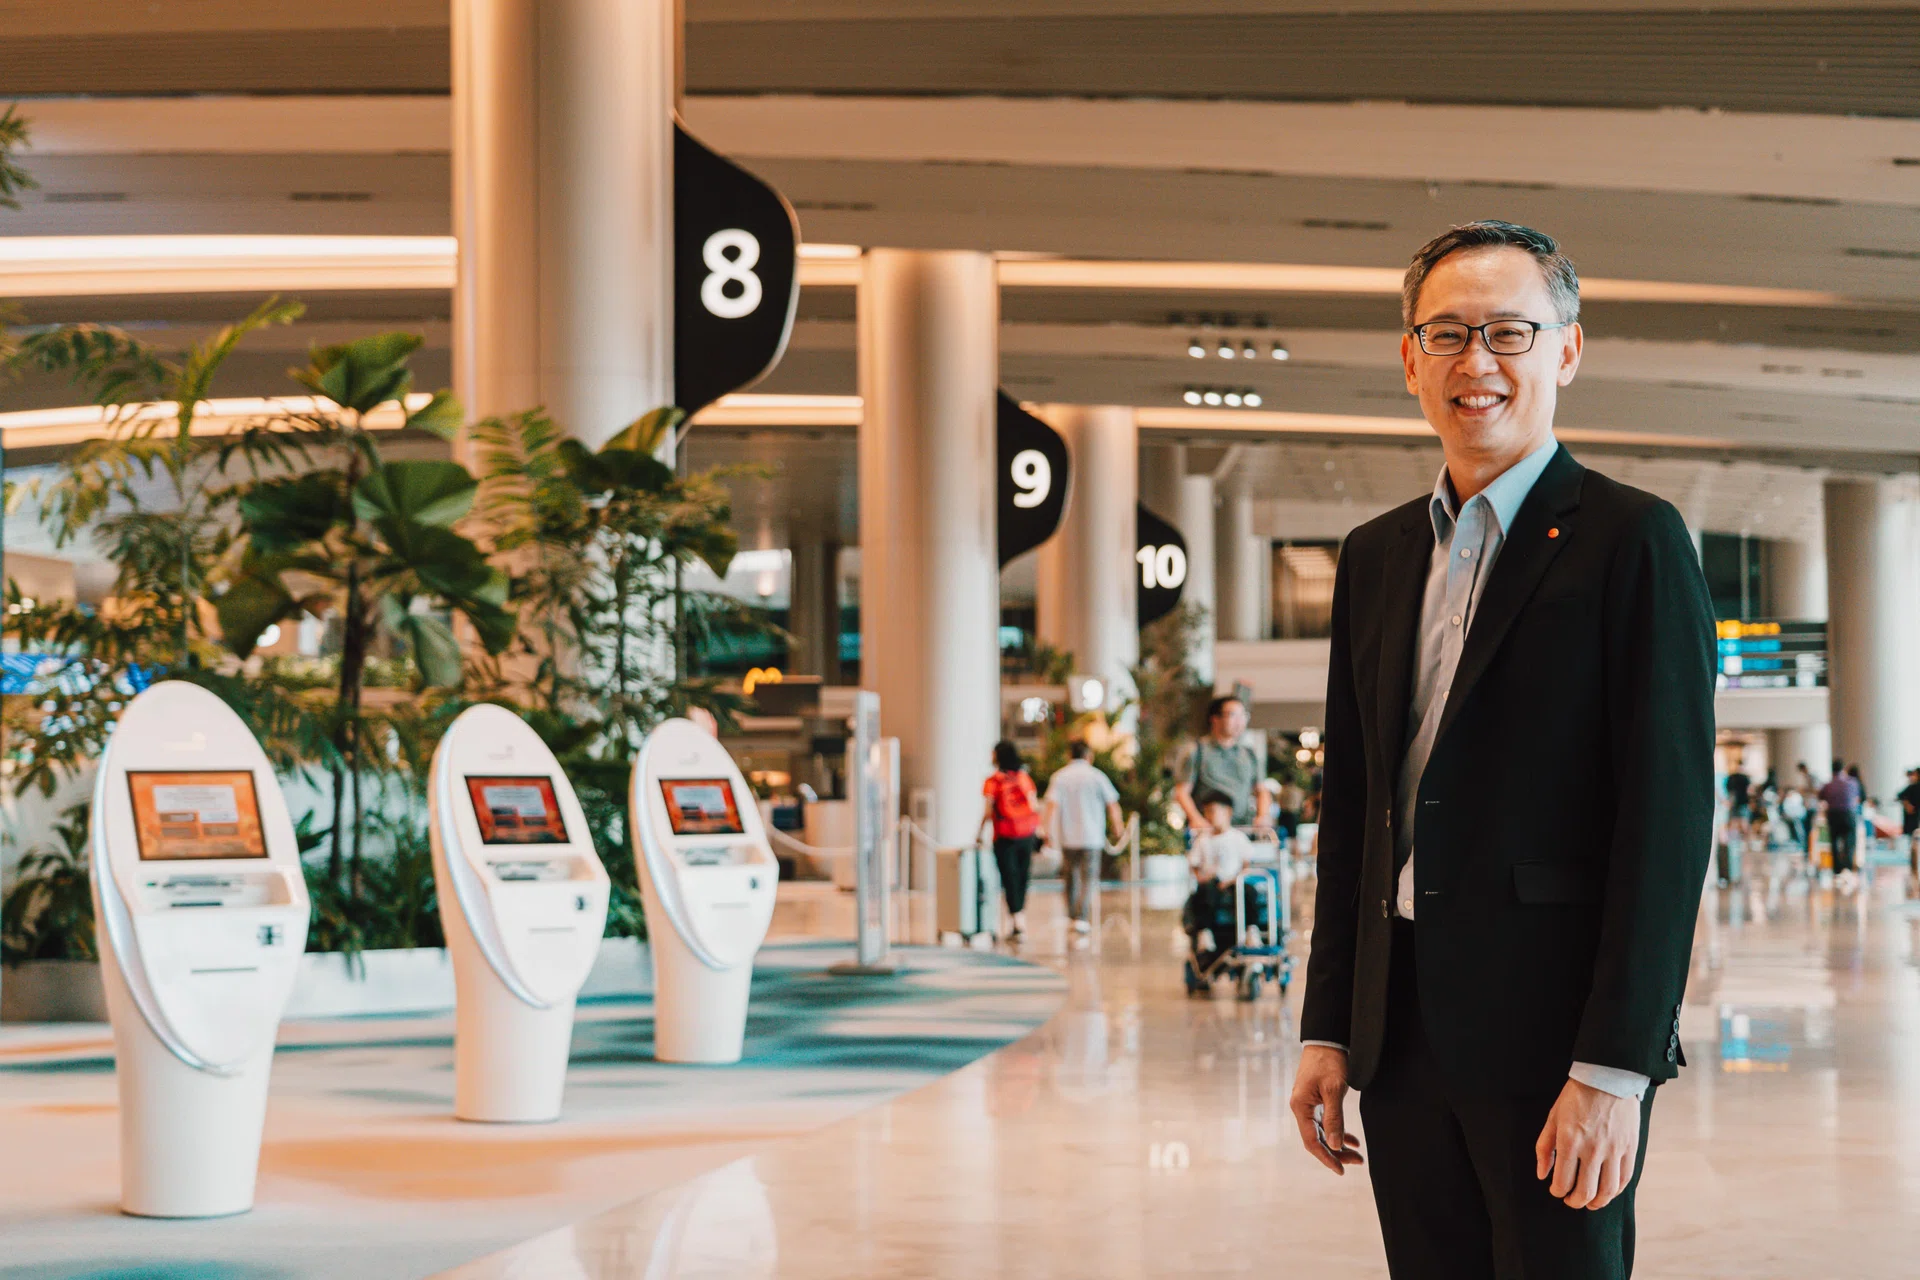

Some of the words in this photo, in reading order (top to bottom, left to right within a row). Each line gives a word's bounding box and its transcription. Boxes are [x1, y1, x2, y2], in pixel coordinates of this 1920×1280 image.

[701, 229, 762, 318] 8
[1011, 450, 1051, 507] 9
[1136, 544, 1187, 589] 10
